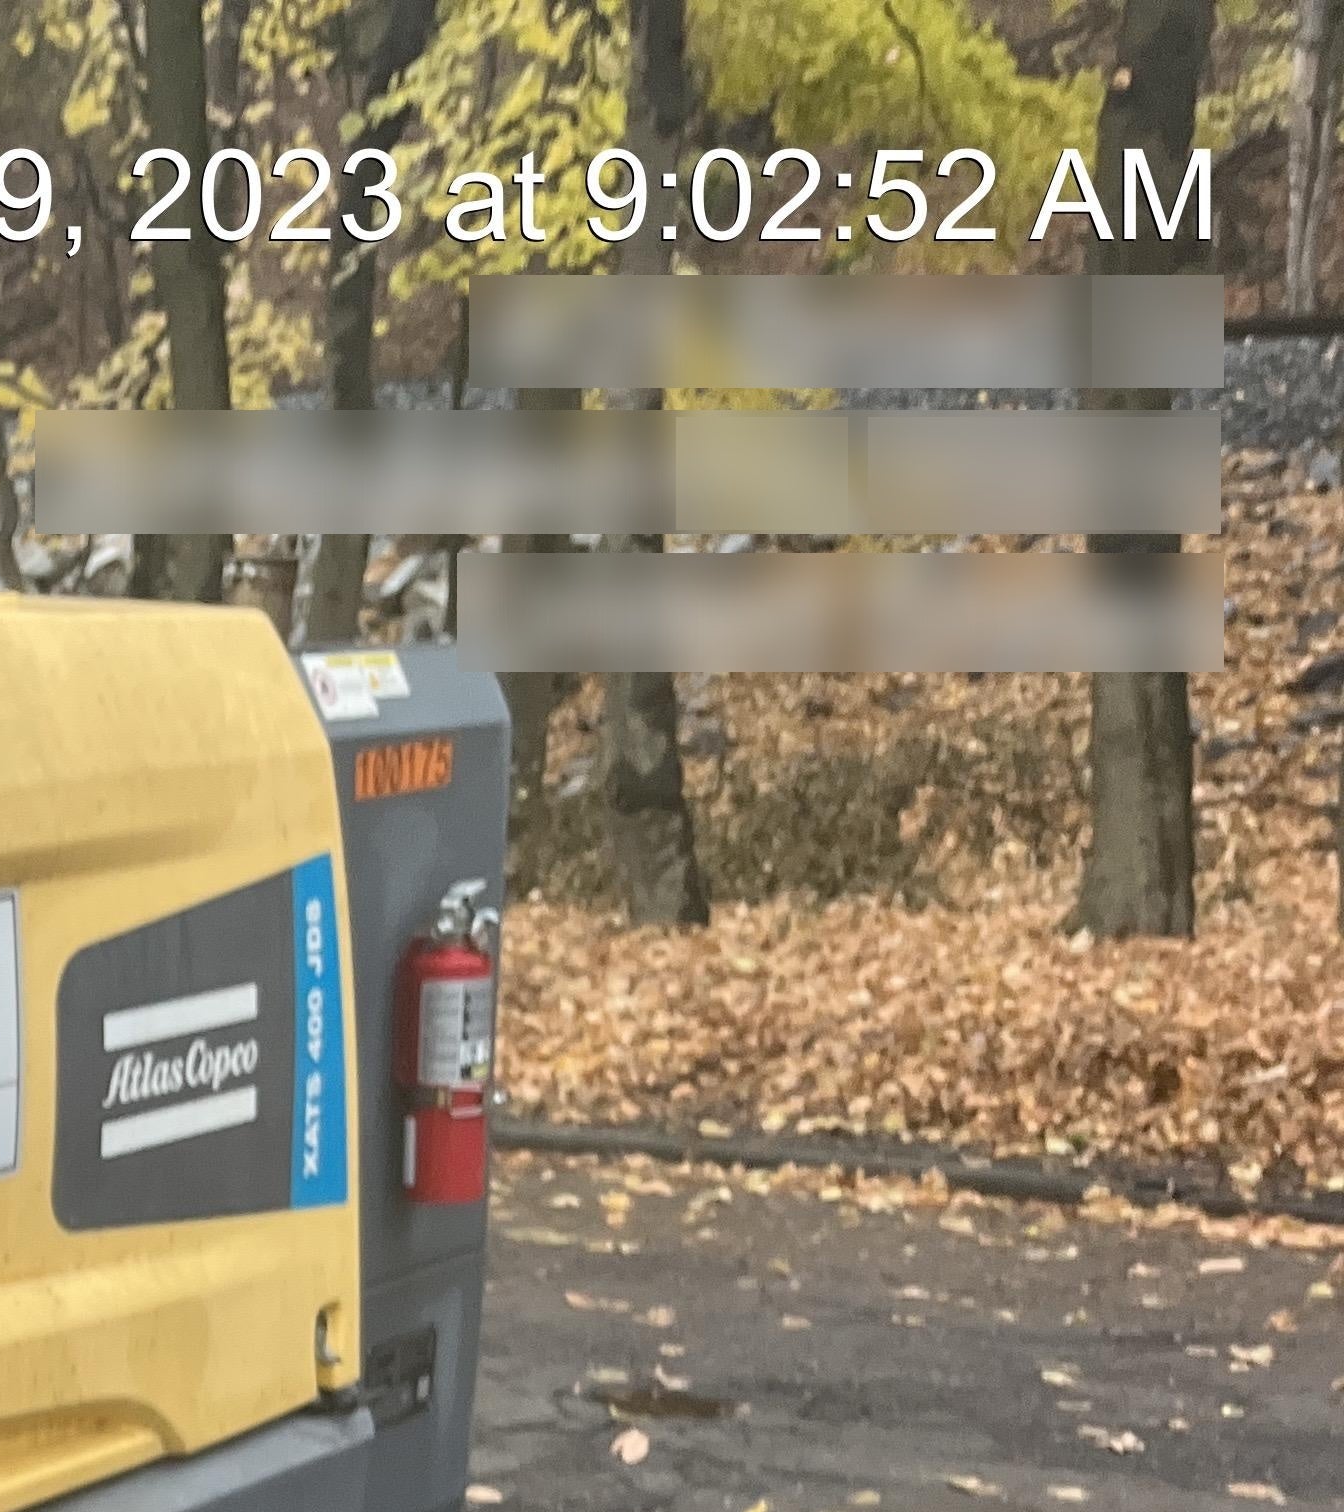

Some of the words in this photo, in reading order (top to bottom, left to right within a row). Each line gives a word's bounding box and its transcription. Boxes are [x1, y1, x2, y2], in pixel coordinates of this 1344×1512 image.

[306, 986, 324, 1064] 400
[102, 1050, 183, 1109] Atlas
[184, 1038, 258, 1091] Copco
[303, 1071, 322, 1180] XATS
